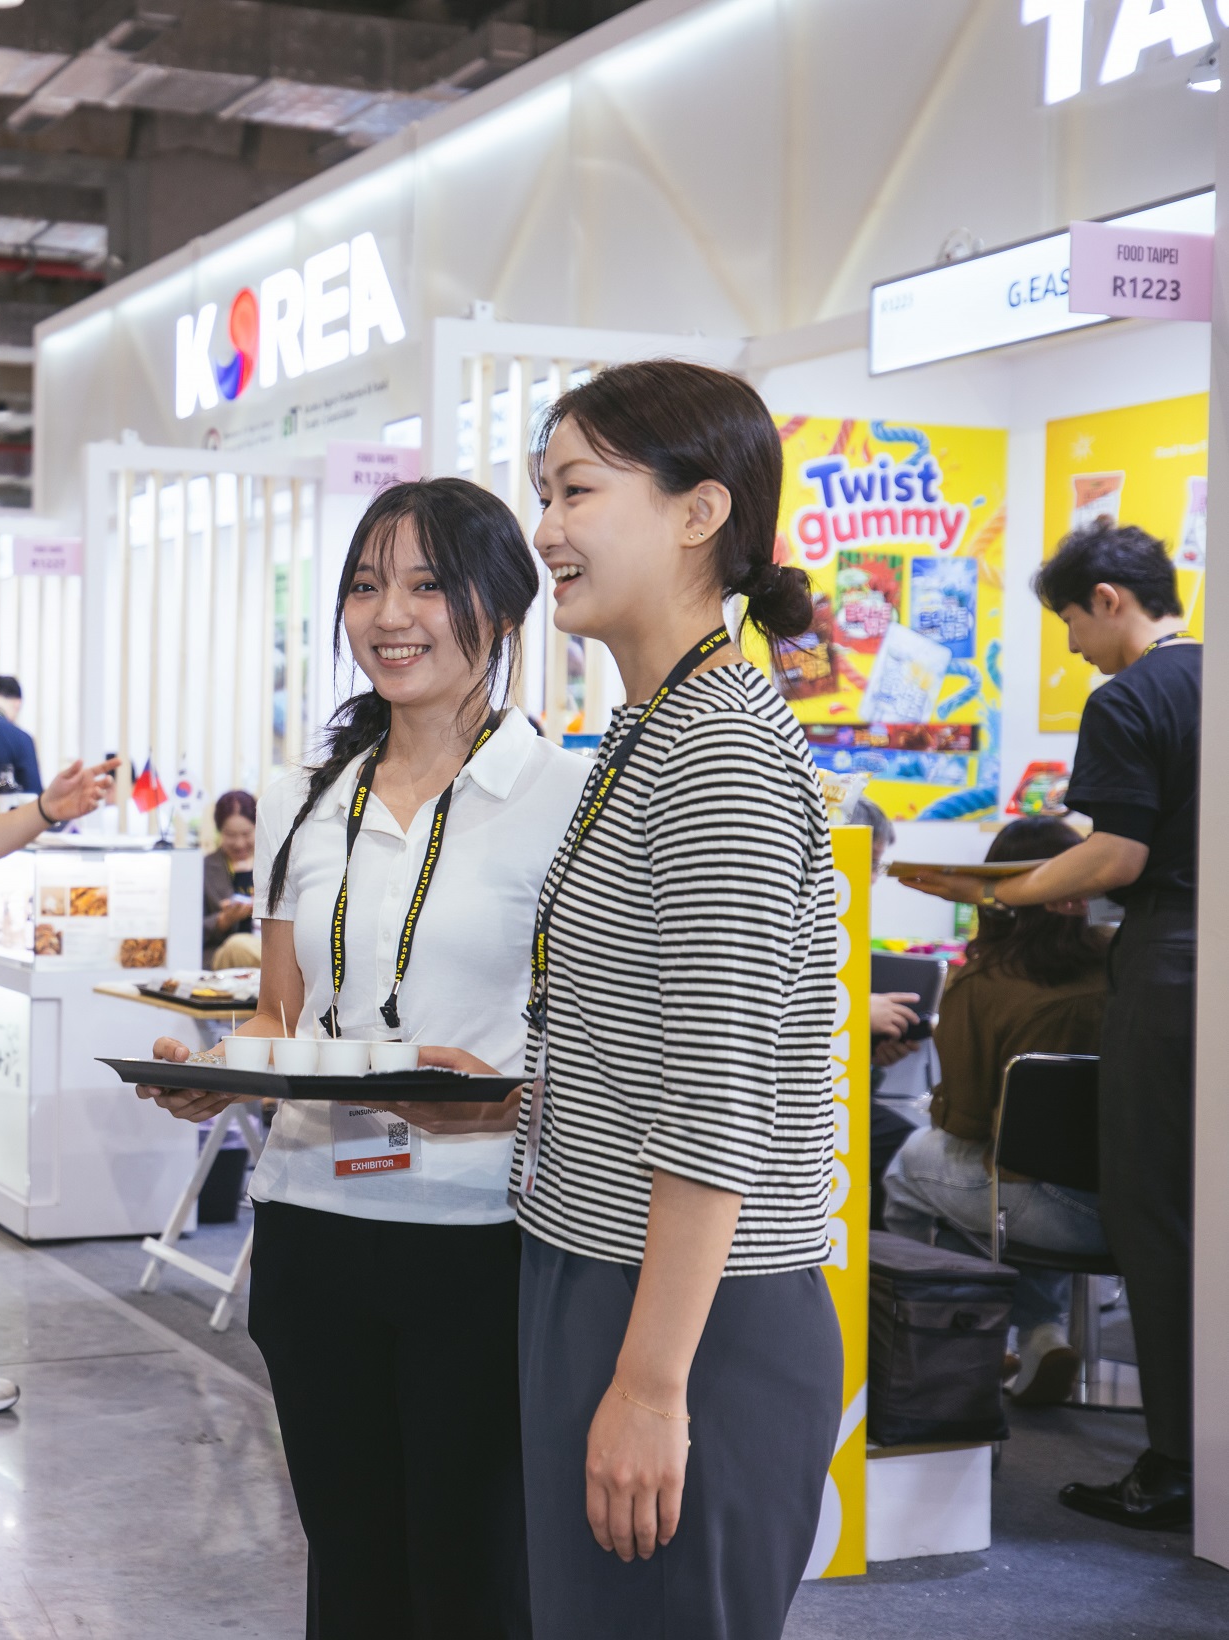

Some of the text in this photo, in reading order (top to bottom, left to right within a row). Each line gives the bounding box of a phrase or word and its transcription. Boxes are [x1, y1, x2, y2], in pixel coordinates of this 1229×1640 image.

[1021, 0, 1229, 106] TA
[1117, 244, 1178, 265] FOOD TAIPEI
[1112, 275, 1181, 301] R1223
[176, 231, 405, 419] KOREA
[806, 460, 938, 508] Twist
[798, 507, 965, 561] gummy
[475, 728, 492, 750] TAITRA
[353, 793, 365, 817] TAITRA
[351, 1159, 394, 1171] EXHIBITOR
